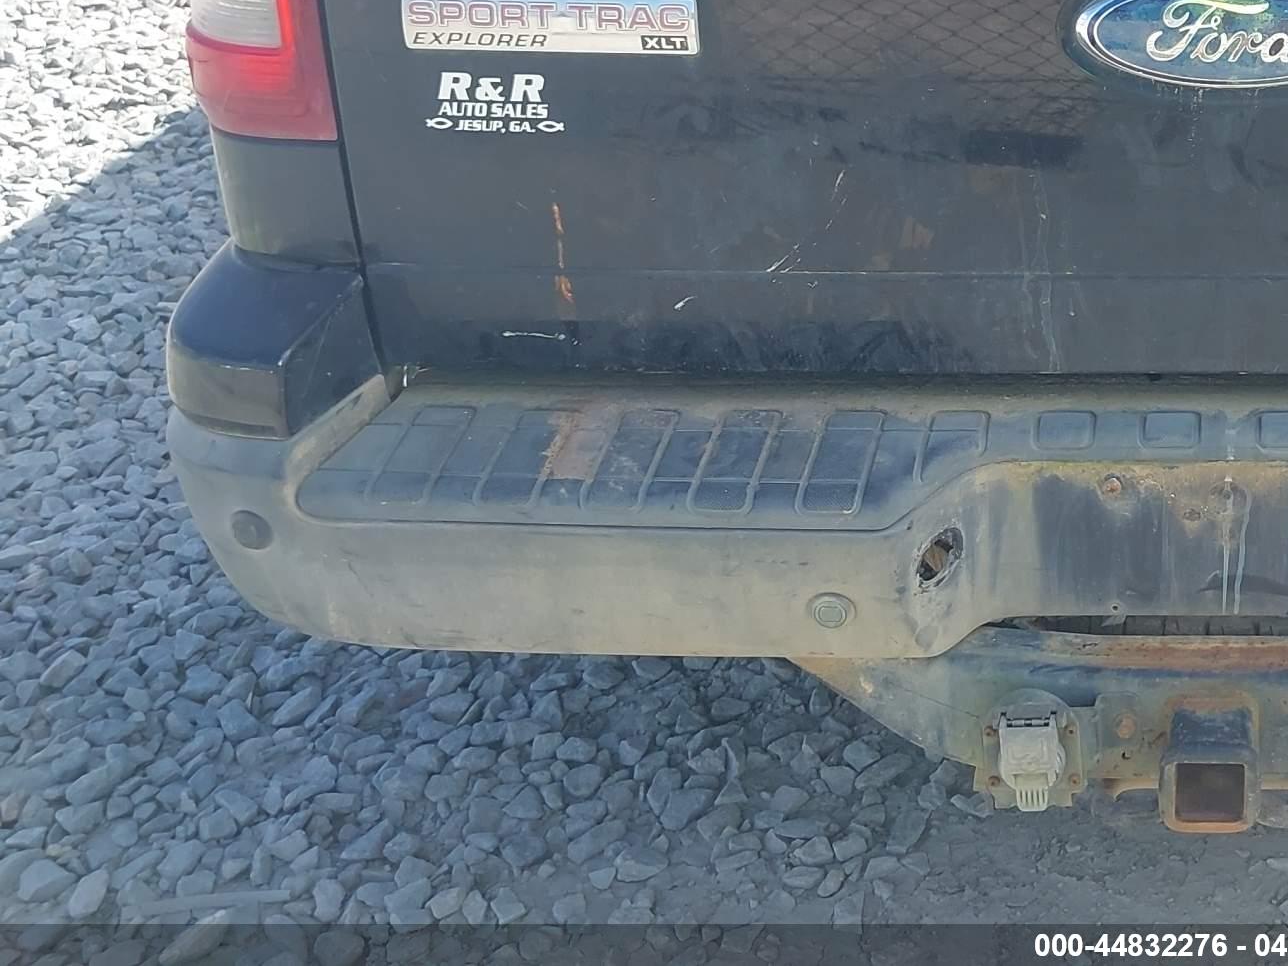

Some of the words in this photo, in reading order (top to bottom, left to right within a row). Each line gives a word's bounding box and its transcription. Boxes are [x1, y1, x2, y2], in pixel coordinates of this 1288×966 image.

[407, 0, 556, 29] SPORT
[567, 2, 691, 32] TRAC
[412, 32, 548, 48] EXPLORER
[642, 36, 686, 50] XLT
[437, 102, 488, 117] AUTO
[490, 103, 549, 118] SALES
